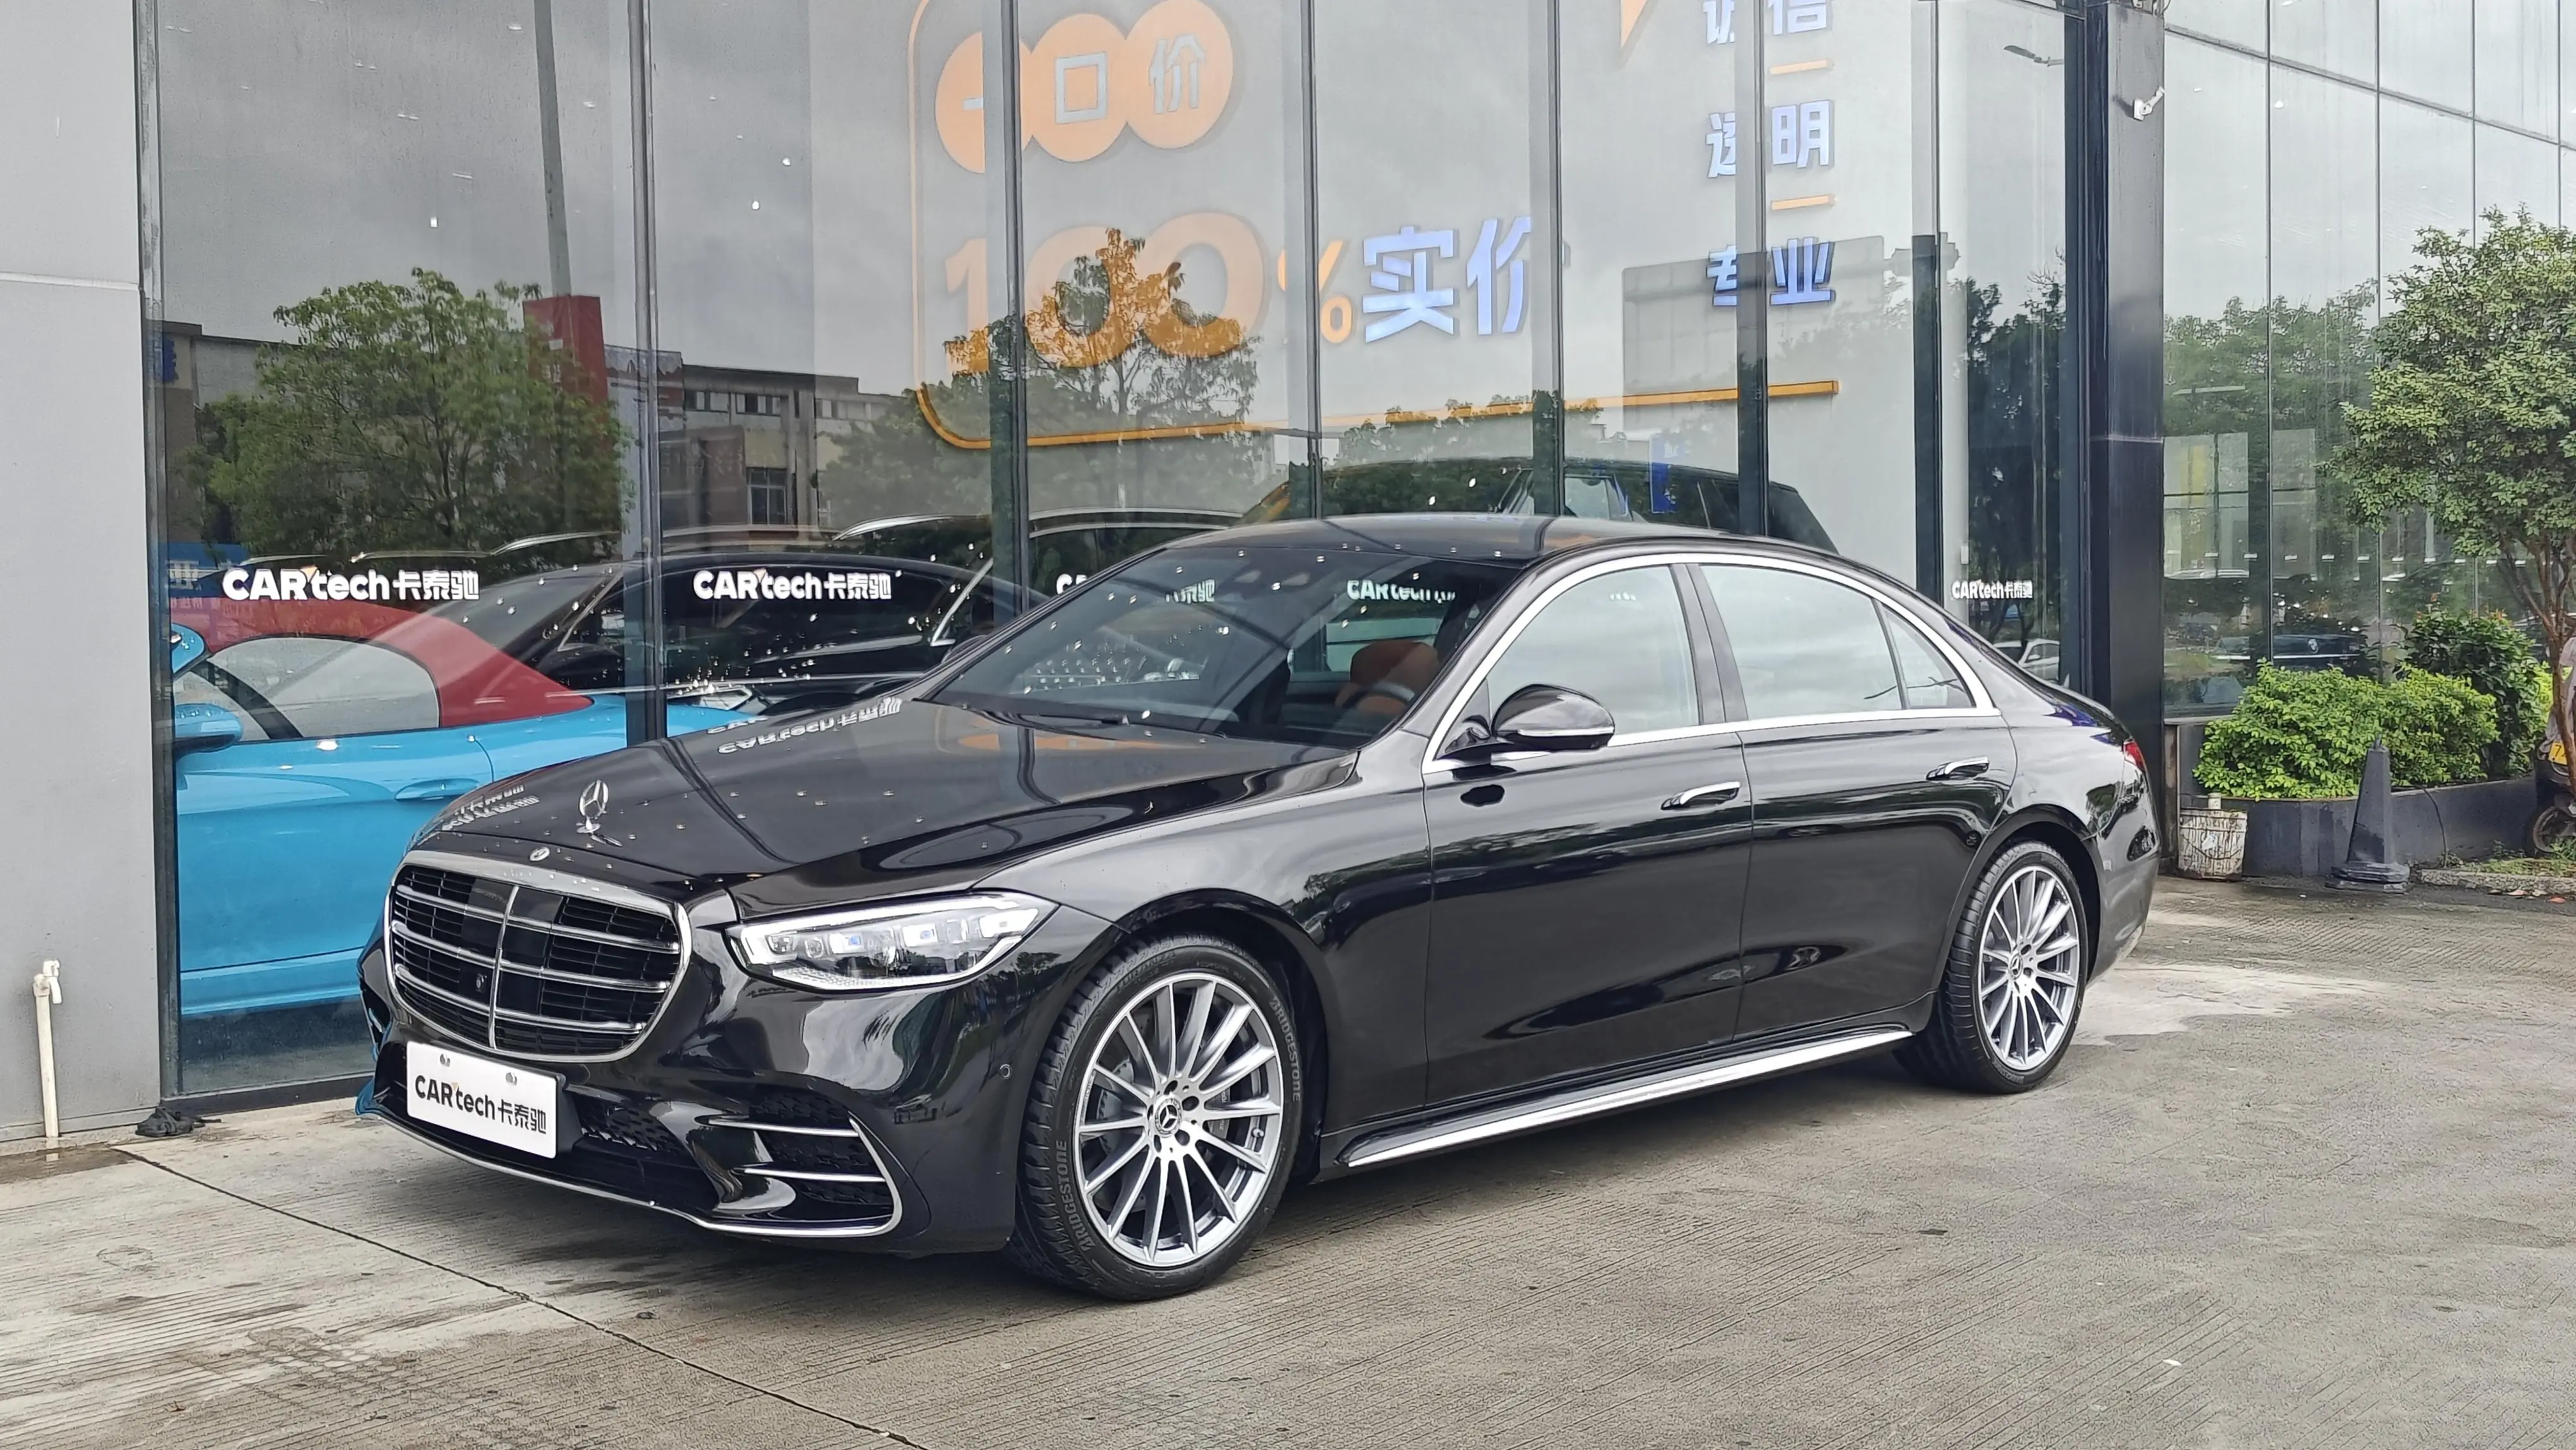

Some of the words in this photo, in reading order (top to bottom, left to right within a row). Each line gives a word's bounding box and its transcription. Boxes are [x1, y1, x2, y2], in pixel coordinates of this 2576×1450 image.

[1702, 0, 1827, 44] 信
[222, 568, 390, 601] CARtech
[393, 569, 480, 601] 卡泰驰
[693, 569, 822, 600] CARtech
[823, 572, 891, 599] 卡泰驰
[1952, 579, 2005, 599] CARtech
[415, 1075, 496, 1120] CARtech
[498, 1099, 547, 1134] 卡泰驰
